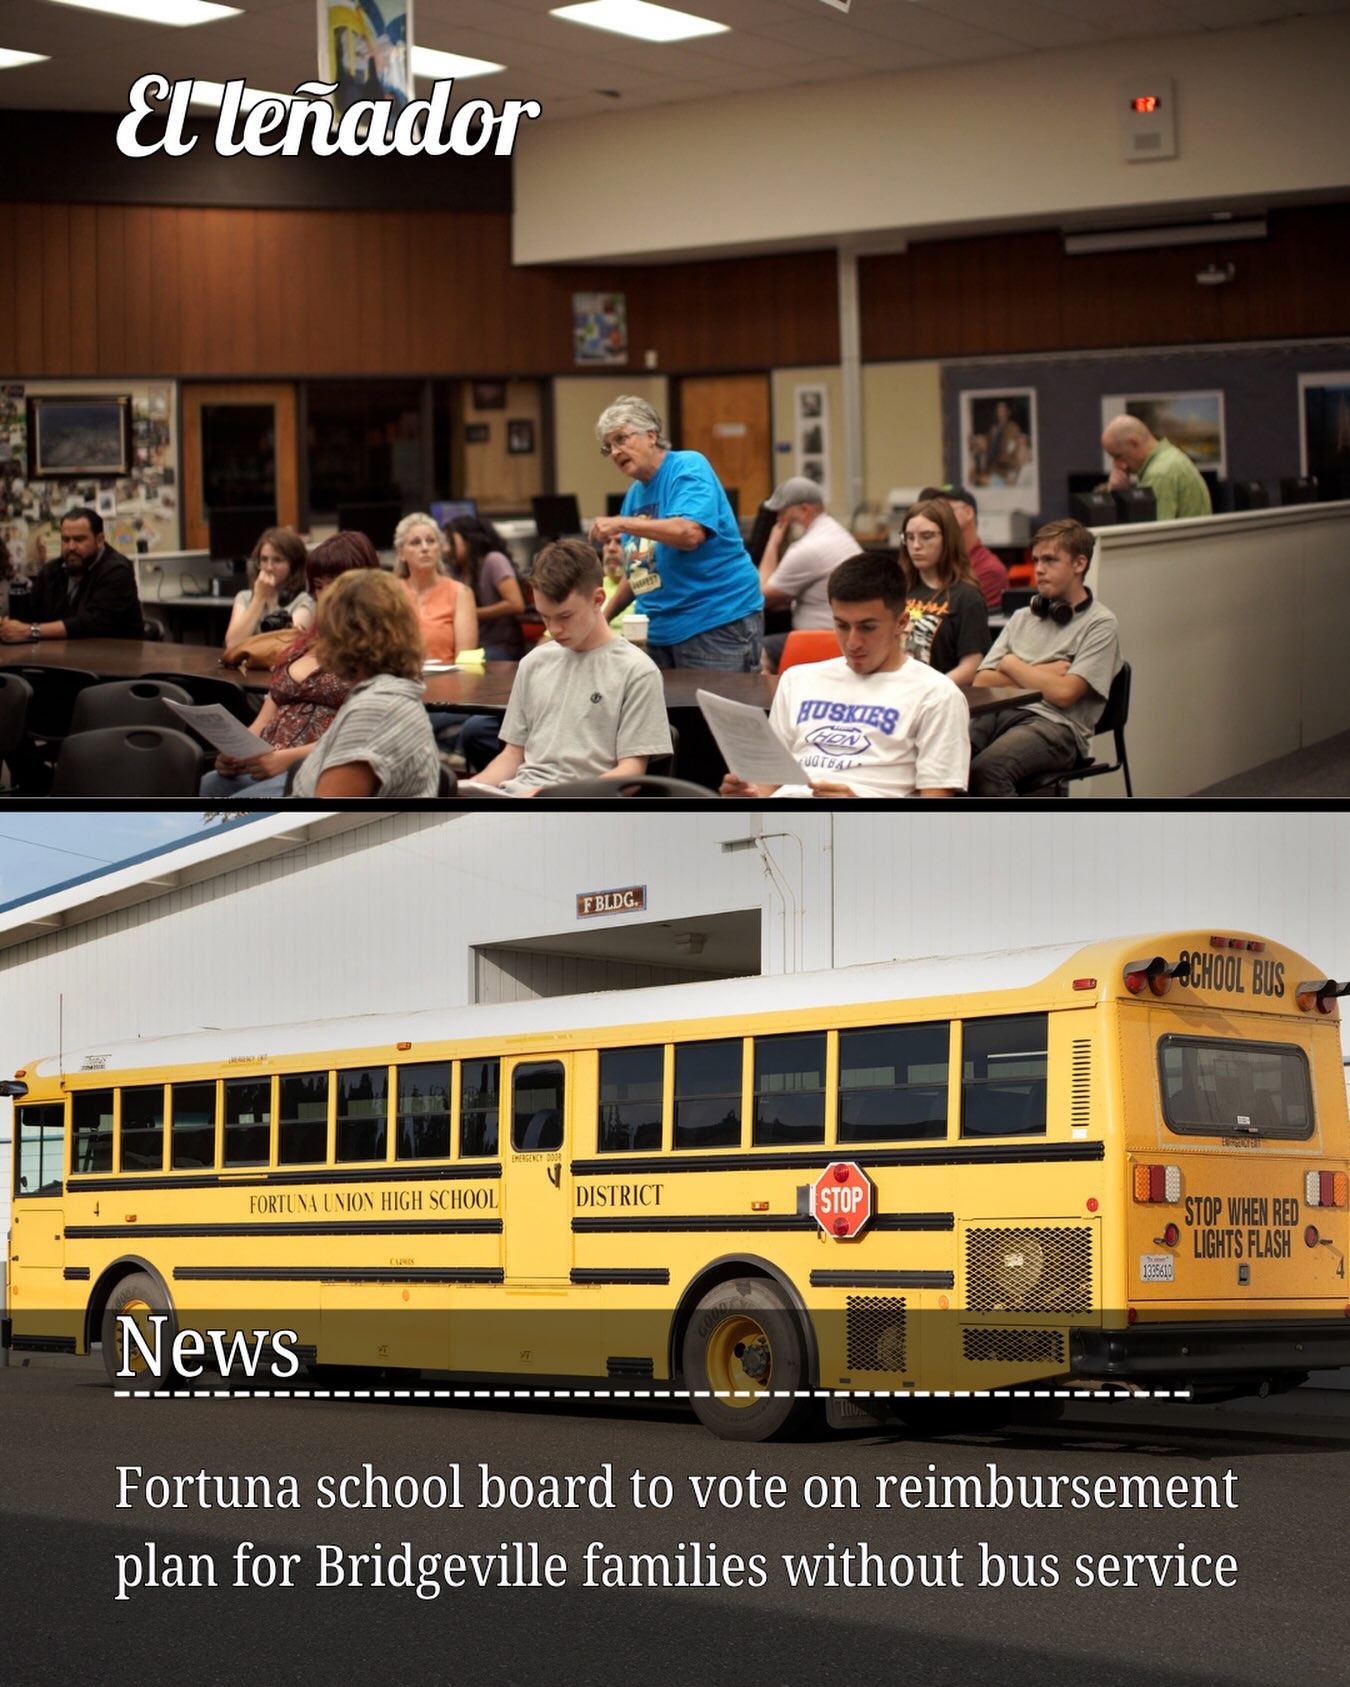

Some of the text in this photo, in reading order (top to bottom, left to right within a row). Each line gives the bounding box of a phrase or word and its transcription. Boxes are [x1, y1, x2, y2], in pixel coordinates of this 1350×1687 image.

[797, 700, 900, 736] HUSKIES
[583, 890, 639, 914] F BLDG.
[1179, 950, 1285, 998] SCHOOL BUS
[511, 1152, 562, 1164] EMERGENCY DOOR
[250, 1184, 664, 1215] FORTUNA UNION HIGH SCHOOL DISTRICT
[820, 1186, 864, 1214] STOP
[1185, 1196, 1299, 1226] STOP WHEN RED
[1194, 1229, 1291, 1258] LIGHTS FLASH
[1336, 1255, 1345, 1279] 4
